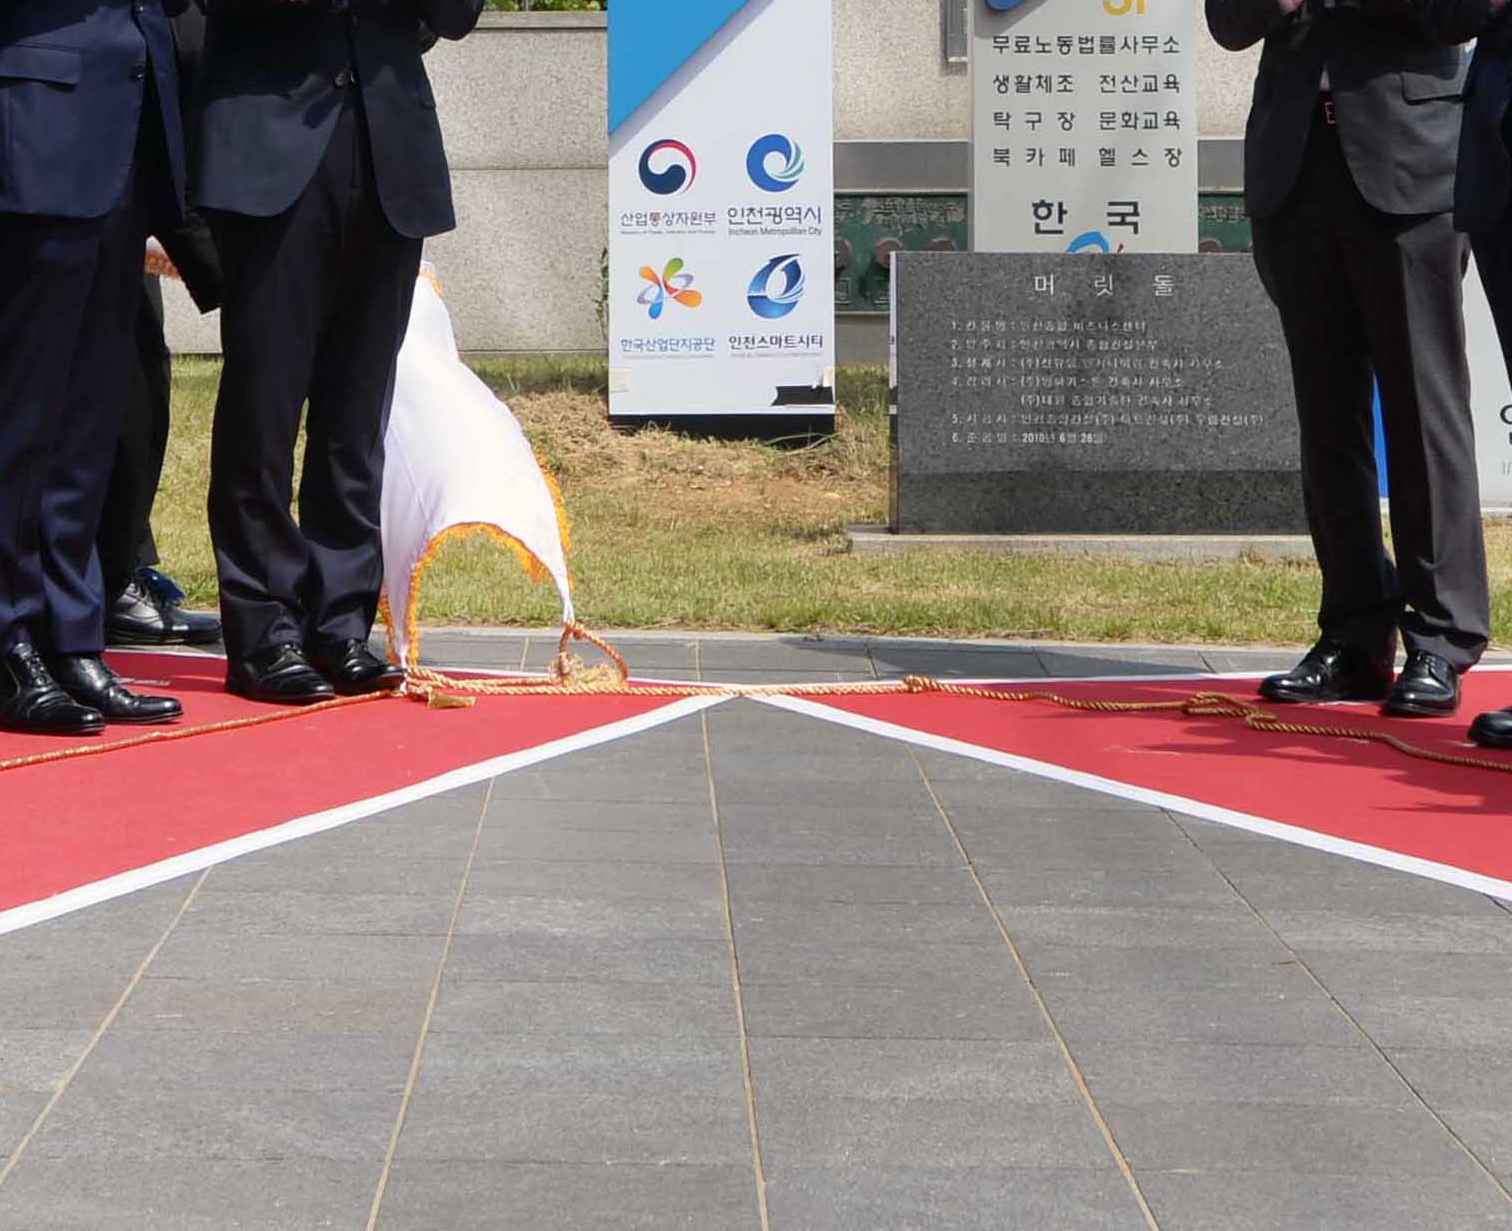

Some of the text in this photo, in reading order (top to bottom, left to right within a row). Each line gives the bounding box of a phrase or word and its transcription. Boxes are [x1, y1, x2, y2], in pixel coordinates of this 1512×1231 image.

[992, 35, 1181, 55] 무료노동법률사무소
[992, 74, 1181, 94] 생활체조 전산교육
[1099, 110, 1181, 131] 문화교육
[620, 211, 717, 227] 산업통상자원부
[727, 206, 822, 226] 인천광역시
[621, 337, 716, 352] 한국산업단지공단
[728, 334, 824, 351] 인천스마트시티
